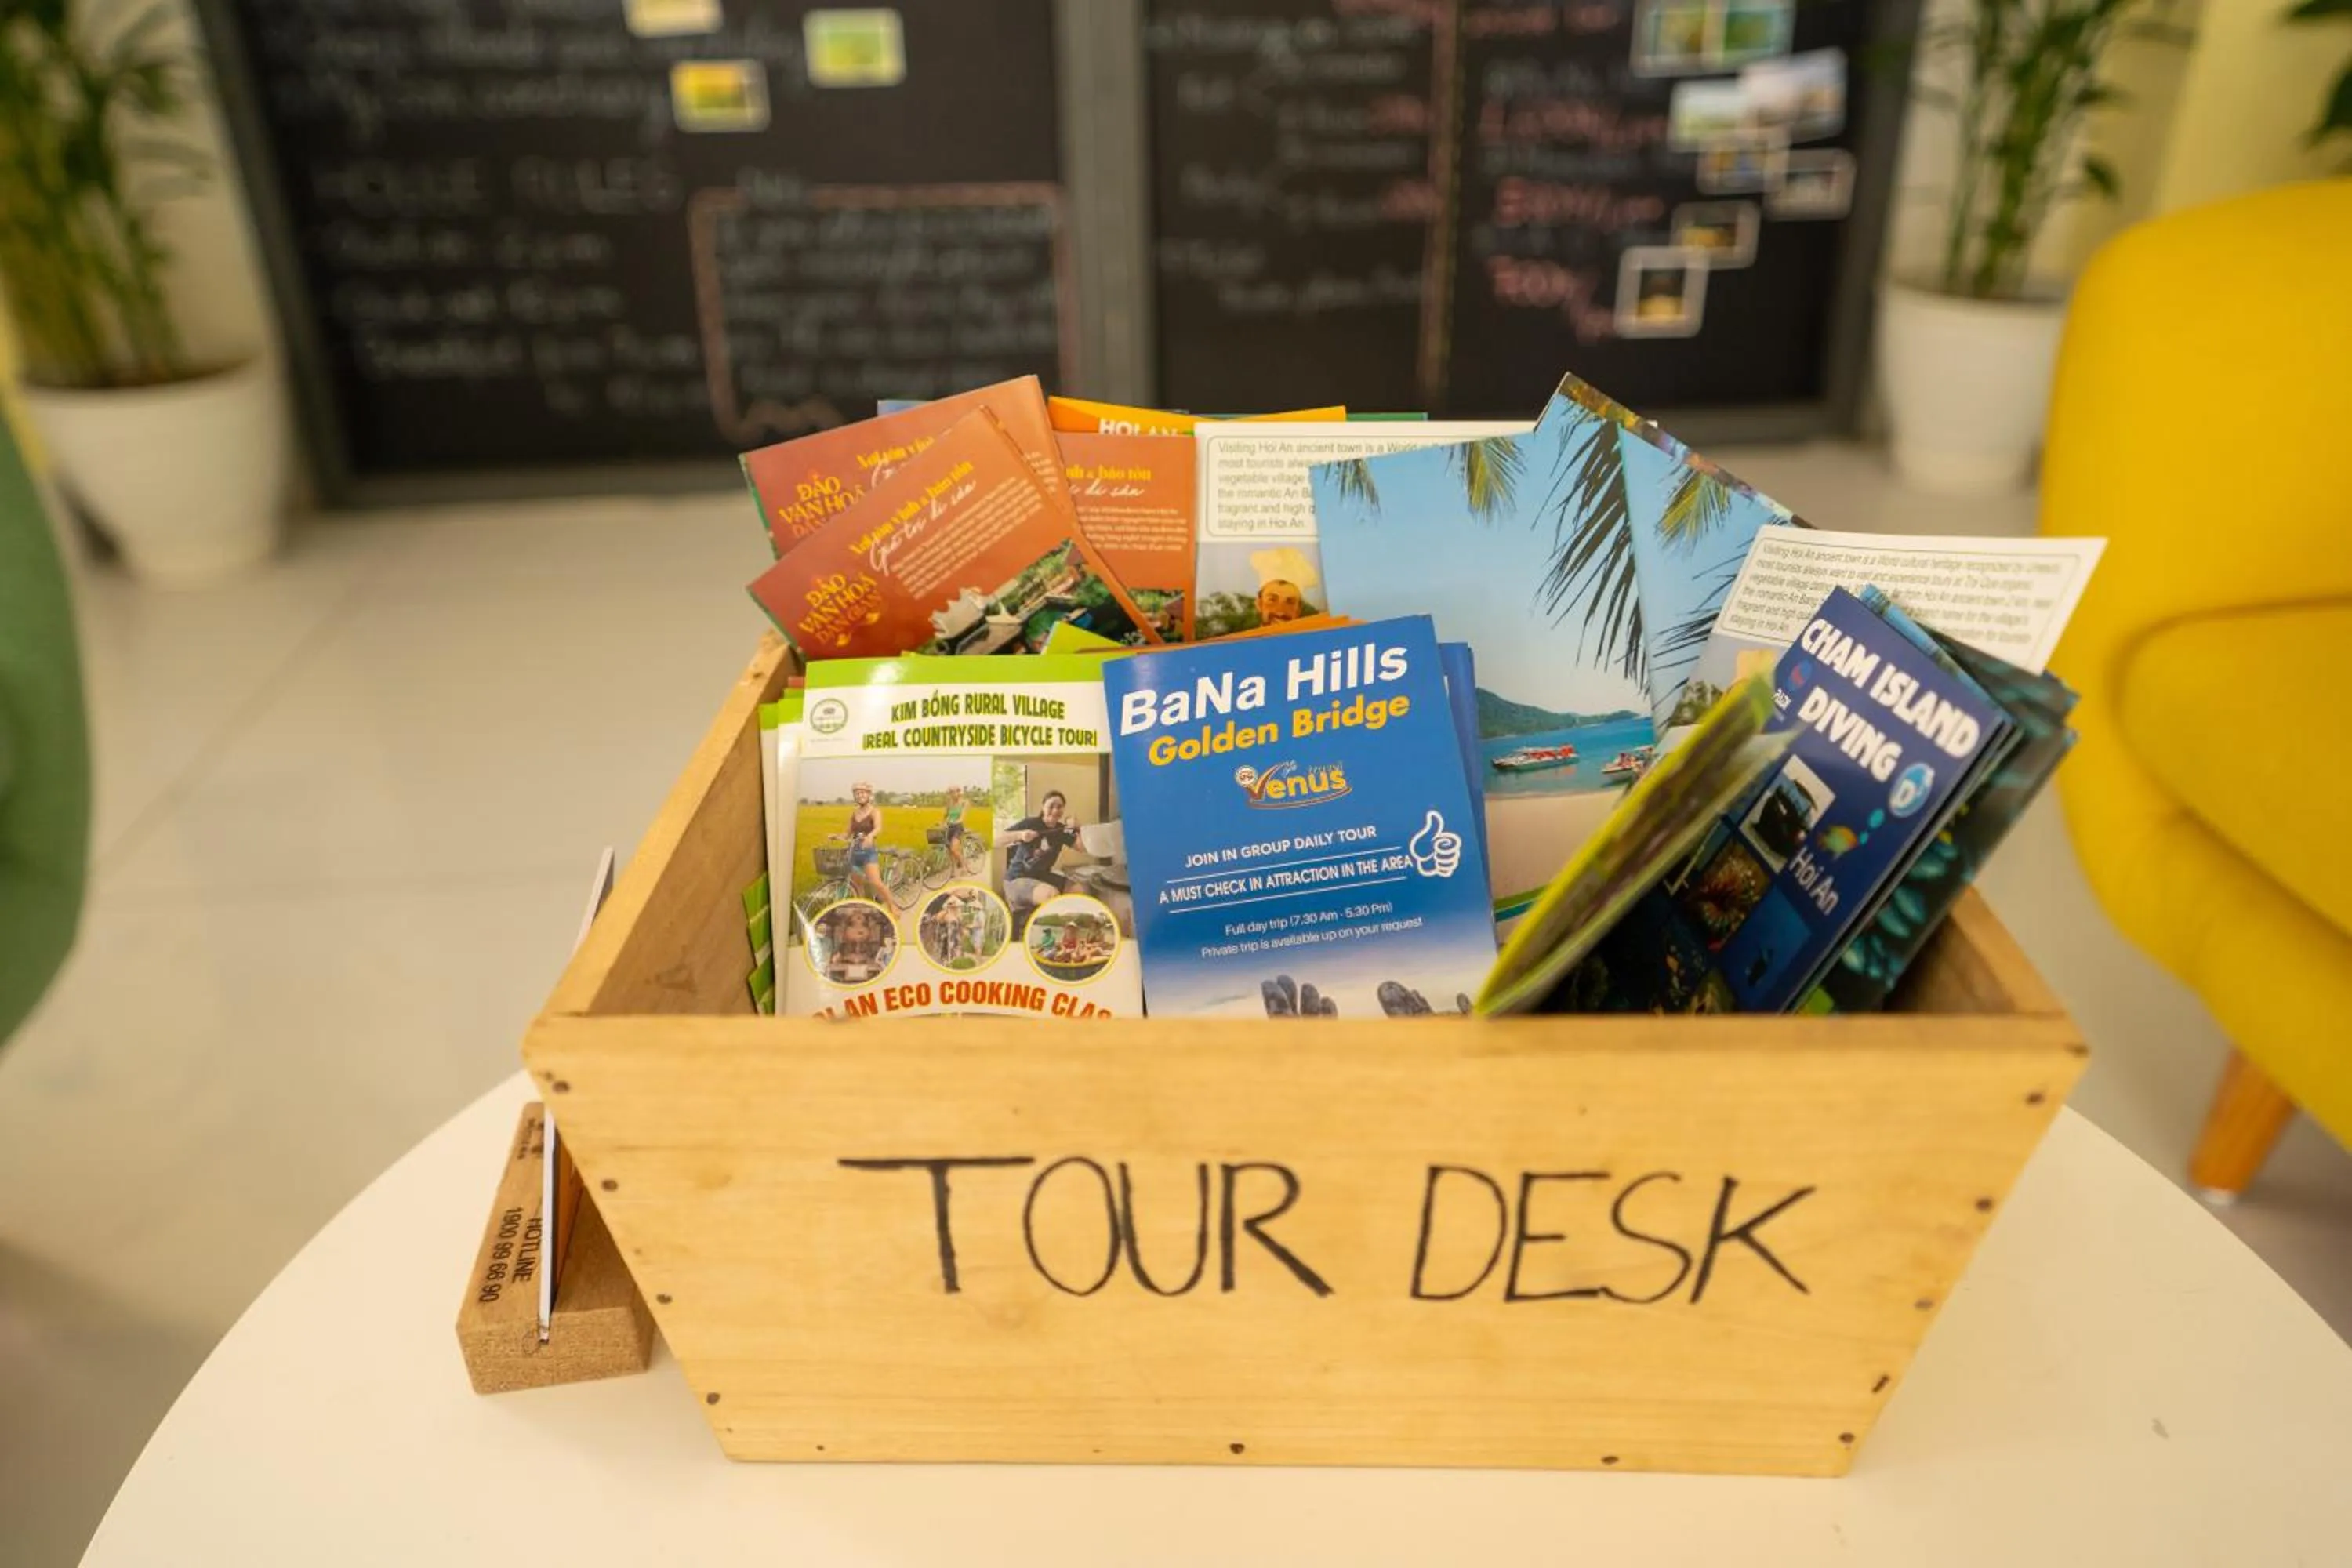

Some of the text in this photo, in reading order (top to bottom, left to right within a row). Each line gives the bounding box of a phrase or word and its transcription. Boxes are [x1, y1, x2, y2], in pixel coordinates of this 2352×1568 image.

[1258, 441, 1278, 453] Hoi
[1279, 441, 1293, 453] An
[1296, 441, 1334, 453] ancient
[1337, 442, 1362, 453] town
[1365, 442, 1373, 453] is
[1377, 444, 1385, 453] a
[1269, 517, 1287, 529] Hoi
[891, 700, 917, 723] KIM
[965, 691, 1007, 715] RURAL
[1013, 694, 1065, 720] VILLAGE
[1120, 643, 1408, 736] BaNa Hills
[1801, 618, 1881, 689] CHAM
[1869, 662, 1980, 758] ISLAND
[903, 723, 996, 748] COUNTRYSIDE
[1000, 724, 1053, 746] BICYCLE
[1148, 694, 1410, 766] Golden Bridge
[1797, 685, 1903, 782] DIVING
[1185, 825, 1377, 868] JOIN IN GROUP DAILY TOUR
[1160, 855, 1414, 904] A MUST CHECK IN ATTRACTION IN THE AREA
[1789, 845, 1839, 916] Hoi An
[1201, 916, 1424, 959] Private trip is available up on your request
[1225, 923, 1246, 936] Full
[1247, 919, 1268, 935] day
[1269, 915, 1288, 931] trip
[1319, 909, 1338, 921] Am
[1345, 905, 1370, 919] 5.30
[844, 992, 879, 1019] AN
[884, 982, 931, 1011] ECO
[938, 980, 1047, 1011] COOKING
[499, 1207, 524, 1238] 1900
[837, 1155, 1816, 1305] TOUR DESK
[492, 1242, 514, 1259] 99
[511, 1218, 542, 1283] HOTLINE
[479, 1283, 502, 1302] 90
